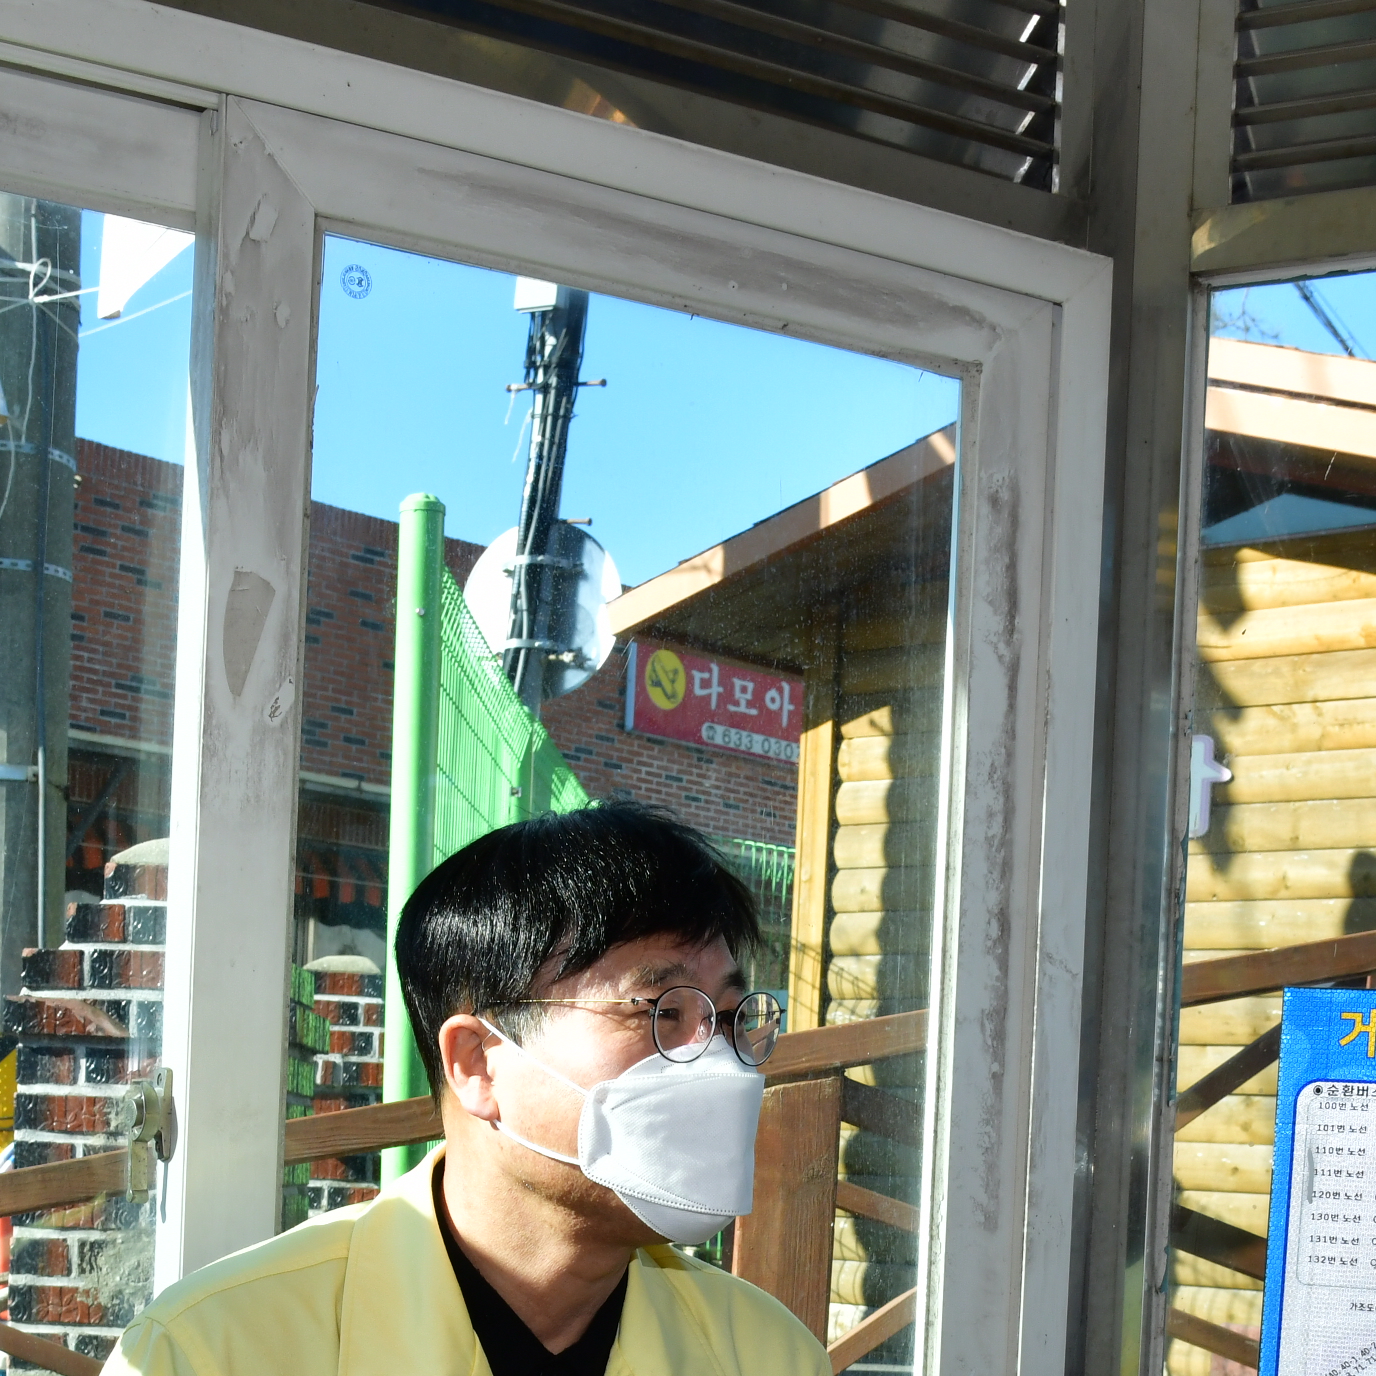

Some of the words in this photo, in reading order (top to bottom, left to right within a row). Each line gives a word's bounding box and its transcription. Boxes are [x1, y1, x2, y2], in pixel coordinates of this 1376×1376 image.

[691, 661, 795, 728] 다모아
[722, 725, 801, 760] 633-030
[1318, 1101, 1347, 1111] 100번
[1349, 1101, 1370, 1112] 노선
[1317, 1124, 1346, 1133] 101번
[1347, 1124, 1368, 1134] 노선
[1315, 1146, 1344, 1156] 110번
[1346, 1146, 1366, 1157] 노선
[1314, 1168, 1342, 1178] 111번
[1345, 1168, 1365, 1179] 노선
[1312, 1190, 1341, 1200] 120번
[1343, 1191, 1363, 1201] 노선
[1311, 1212, 1339, 1222] 130번
[1342, 1213, 1362, 1224] 노선
[1309, 1234, 1338, 1244] 131번
[1340, 1235, 1360, 1246] 노선
[1307, 1255, 1336, 1265] 132번
[1339, 1256, 1359, 1267] 노선
